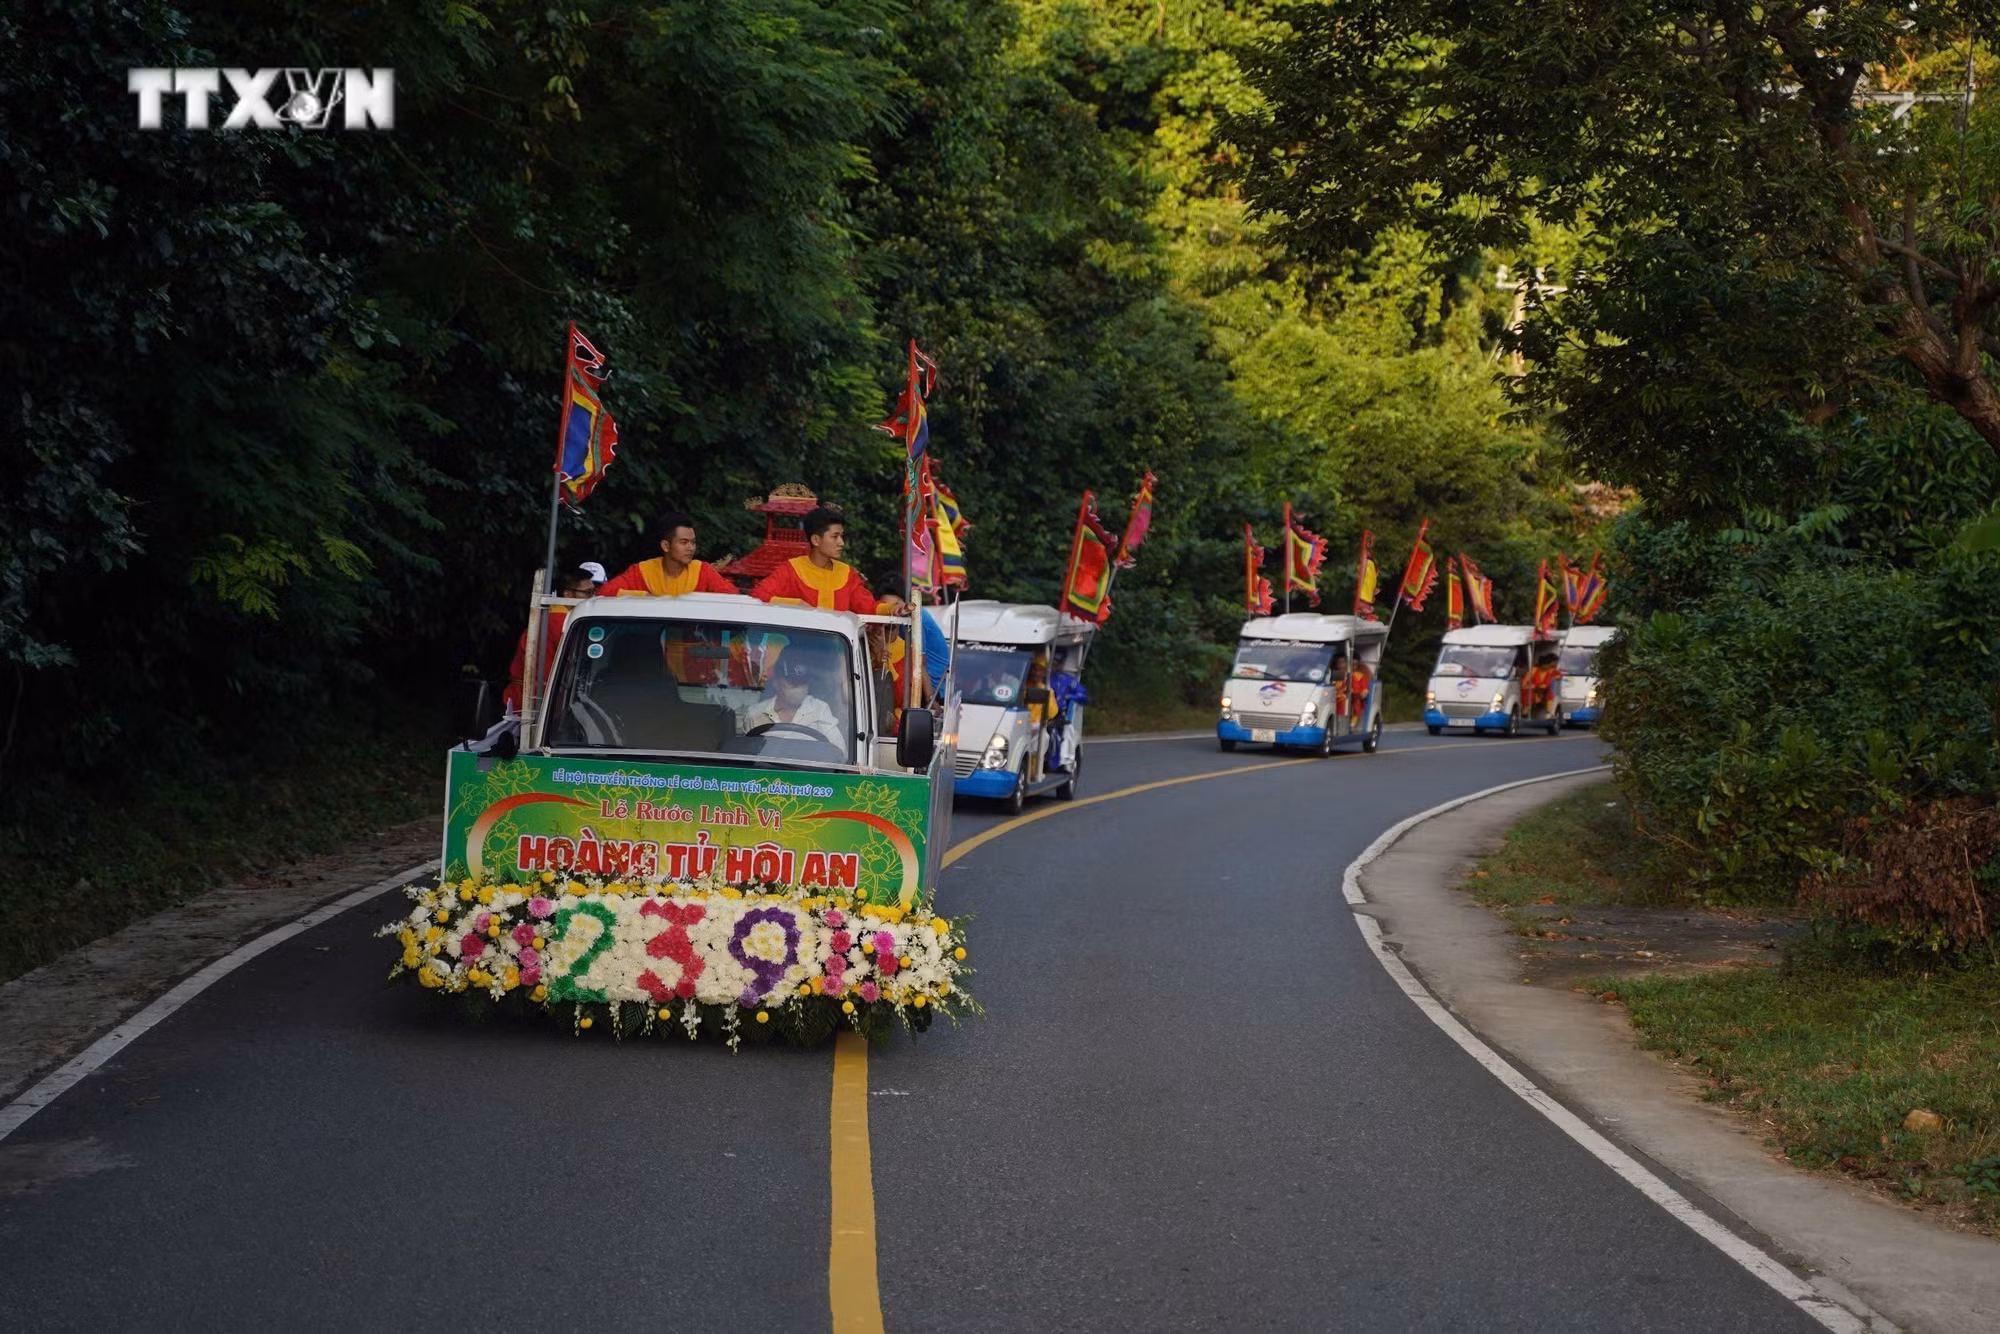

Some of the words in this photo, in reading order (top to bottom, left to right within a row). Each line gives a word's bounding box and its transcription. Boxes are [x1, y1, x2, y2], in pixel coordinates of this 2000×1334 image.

[965, 641, 1017, 653] Tourist
[552, 768, 565, 782] LỄ
[566, 770, 586, 785] HỘI
[588, 771, 626, 785] TRUYỀN
[628, 773, 665, 788] THỐNG
[667, 775, 680, 788] LỄ
[703, 778, 719, 791] BÀ
[720, 781, 739, 792] PHI
[740, 779, 761, 793] YẾN
[768, 781, 789, 795] LẦN
[790, 784, 812, 796] THỨ
[813, 786, 833, 798] 239
[600, 799, 629, 819] Lễ
[636, 800, 694, 823] Rước
[700, 804, 750, 826] Linh
[756, 807, 782, 832] Vị
[518, 827, 658, 879] HOÀNG
[665, 831, 719, 881] TỬ
[800, 851, 859, 888] AN
[549, 900, 801, 1007] 239
